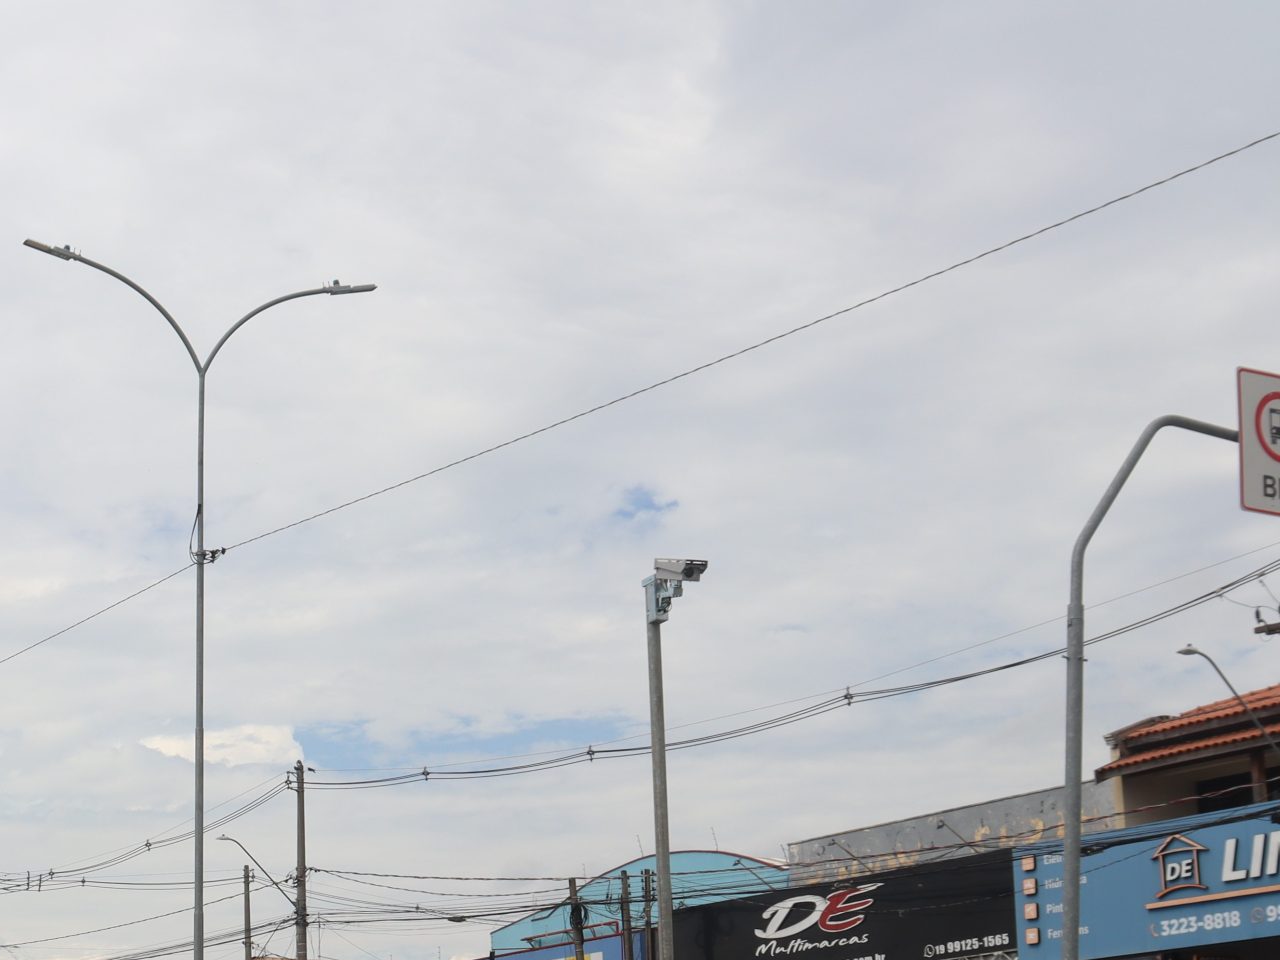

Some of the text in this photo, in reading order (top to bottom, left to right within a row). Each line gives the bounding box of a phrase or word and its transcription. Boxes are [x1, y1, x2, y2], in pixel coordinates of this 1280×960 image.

[1263, 474, 1280, 499] B
[1166, 859, 1192, 881] DE
[754, 883, 884, 938] DE
[1160, 910, 1240, 936] 3223-8818
[755, 933, 869, 956] Multimarcas
[935, 933, 1009, 955] 19 99125-1565
